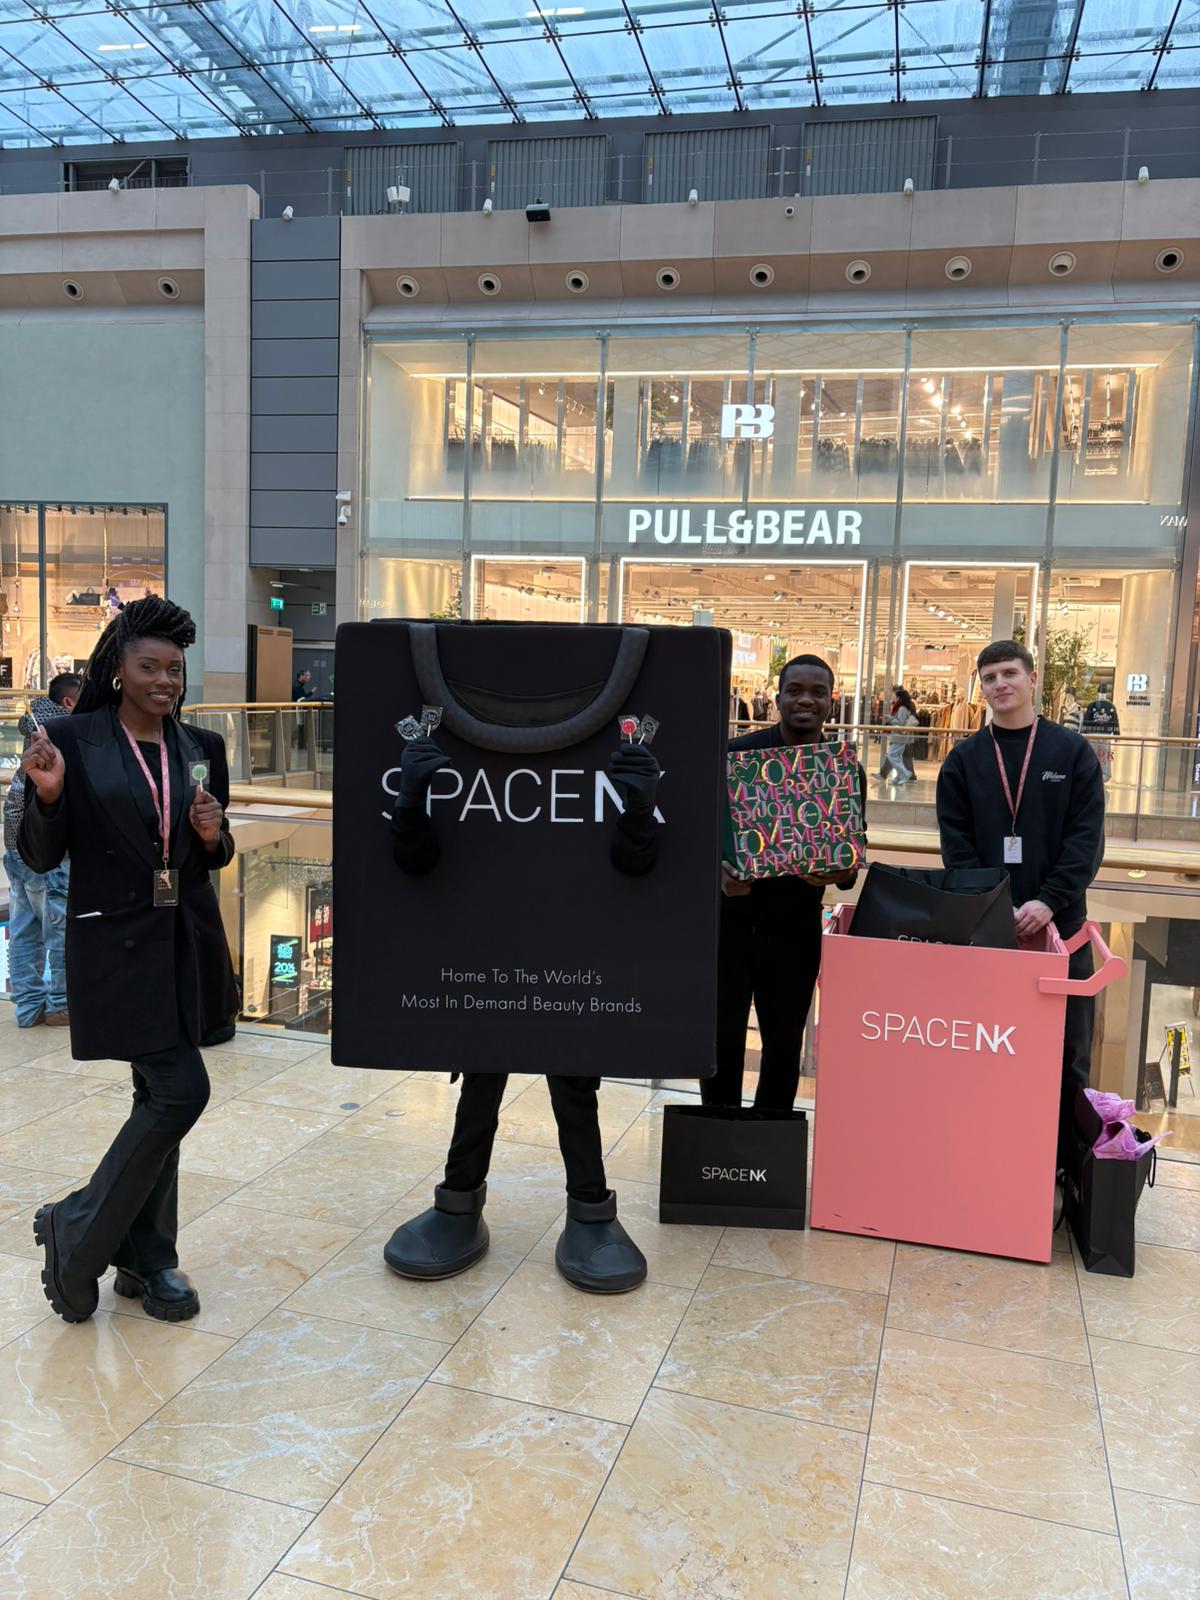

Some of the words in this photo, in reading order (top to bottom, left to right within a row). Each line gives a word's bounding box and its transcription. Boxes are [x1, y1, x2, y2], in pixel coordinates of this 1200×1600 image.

[628, 509, 862, 545] PULL&BEAR
[441, 968, 487, 984] Home
[491, 968, 509, 984] To
[513, 968, 539, 984] The
[543, 969, 602, 986] World's
[401, 993, 440, 1009] Most
[445, 994, 458, 1009] In
[464, 994, 527, 1011] Demand
[533, 996, 585, 1016] Beauty
[590, 997, 642, 1013] Brands
[861, 1010, 1017, 1056] SPACENK
[701, 1166, 767, 1183] SPACENK
